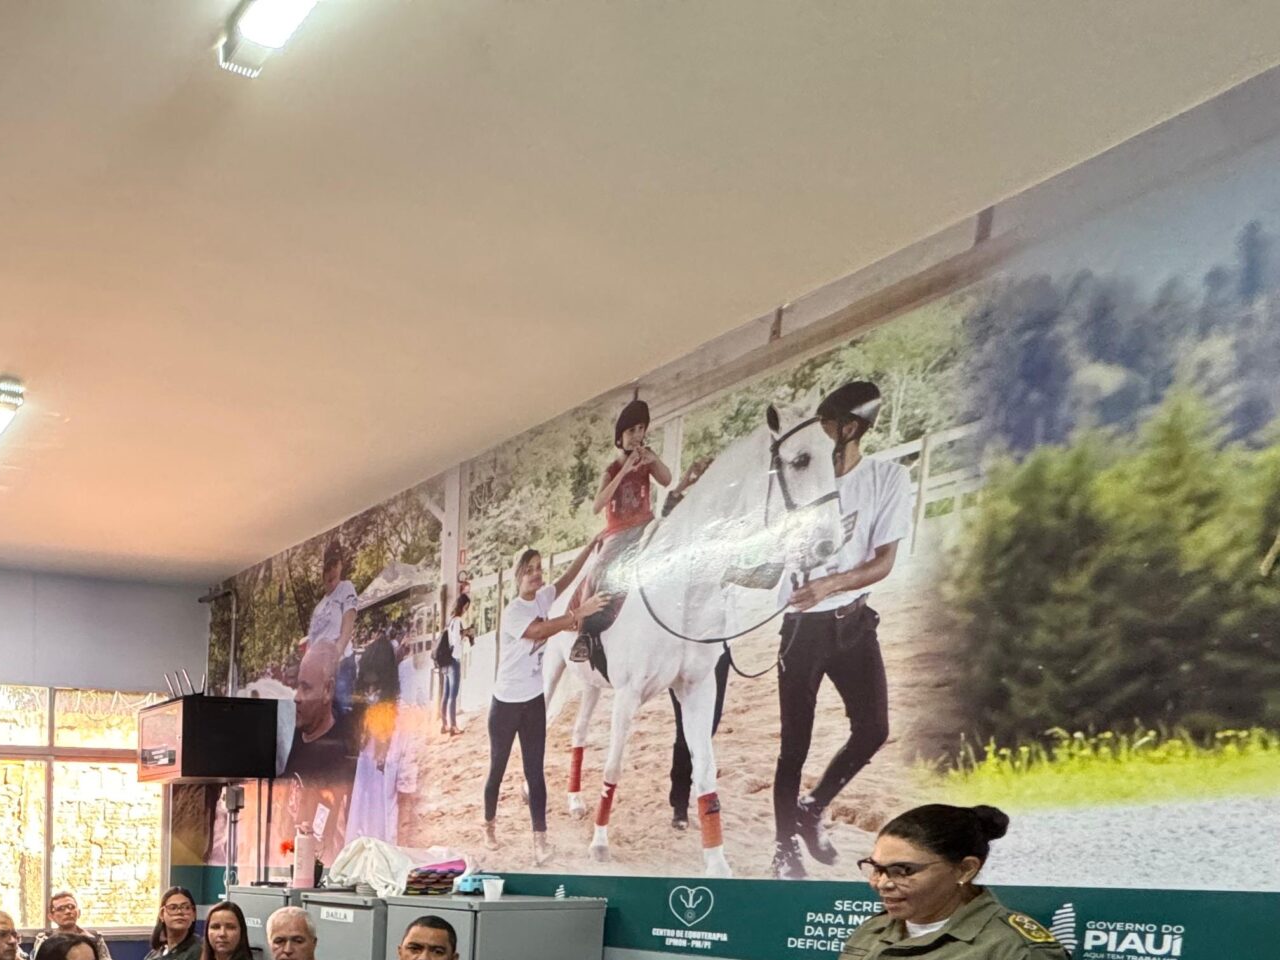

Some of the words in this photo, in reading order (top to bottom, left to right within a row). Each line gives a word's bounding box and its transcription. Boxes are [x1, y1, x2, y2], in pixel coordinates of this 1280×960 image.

[834, 900, 884, 913] SECRE
[806, 912, 845, 925] PARA
[804, 926, 824, 937] DA
[1086, 920, 1158, 933] GOVERNO
[1161, 924, 1185, 934] DO
[675, 930, 684, 938] DE
[1083, 930, 1183, 957] PIAUÍ
[1106, 952, 1124, 960] TEM
